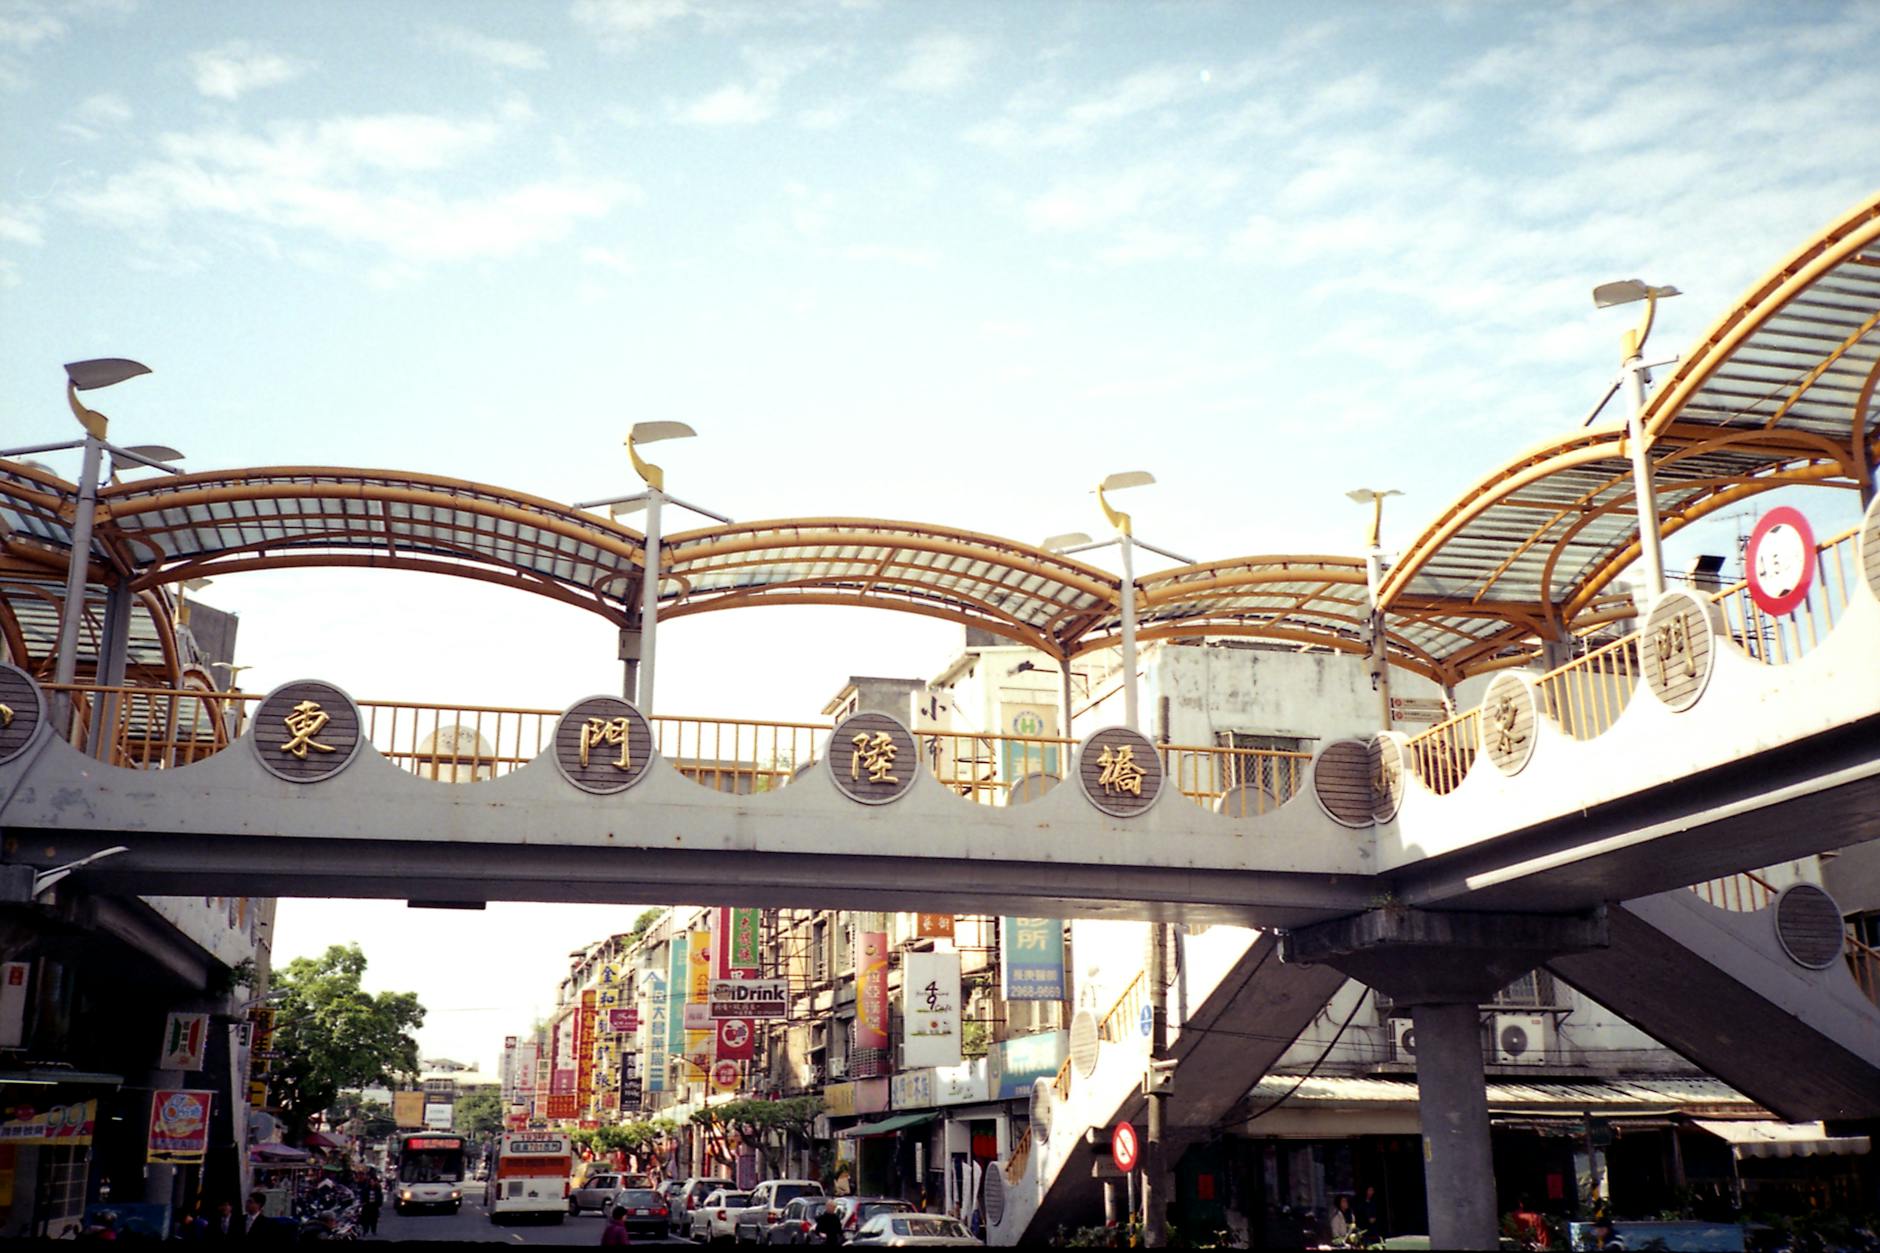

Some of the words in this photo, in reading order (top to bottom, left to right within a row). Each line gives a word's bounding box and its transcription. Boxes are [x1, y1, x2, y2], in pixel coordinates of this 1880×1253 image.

[281, 700, 337, 760] 東
[580, 717, 631, 771] 門
[852, 731, 899, 785] 陸
[1096, 744, 1147, 797] 橋
[731, 984, 785, 1002] iDrink
